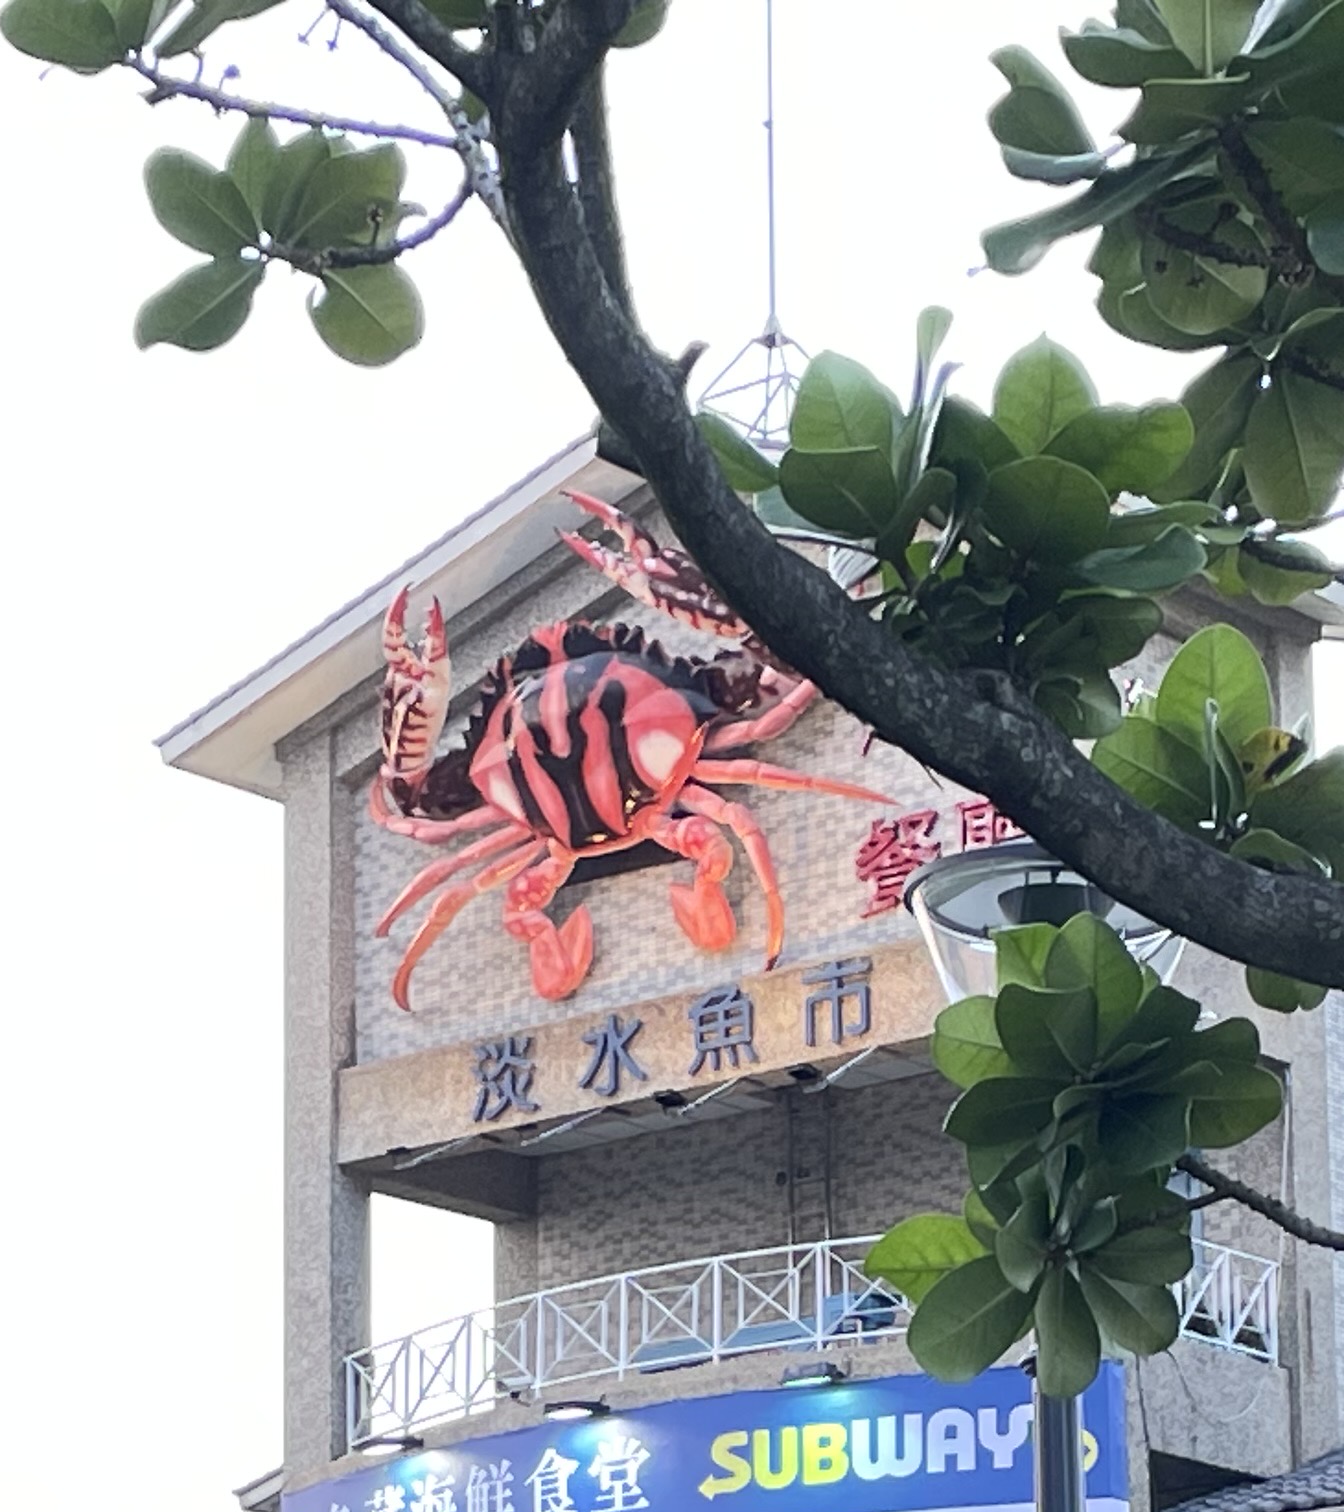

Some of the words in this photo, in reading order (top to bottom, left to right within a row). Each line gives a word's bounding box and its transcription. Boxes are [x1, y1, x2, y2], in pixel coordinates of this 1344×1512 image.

[471, 956, 873, 1122] 淡水魚市
[698, 1402, 1035, 1501] SUBWAY
